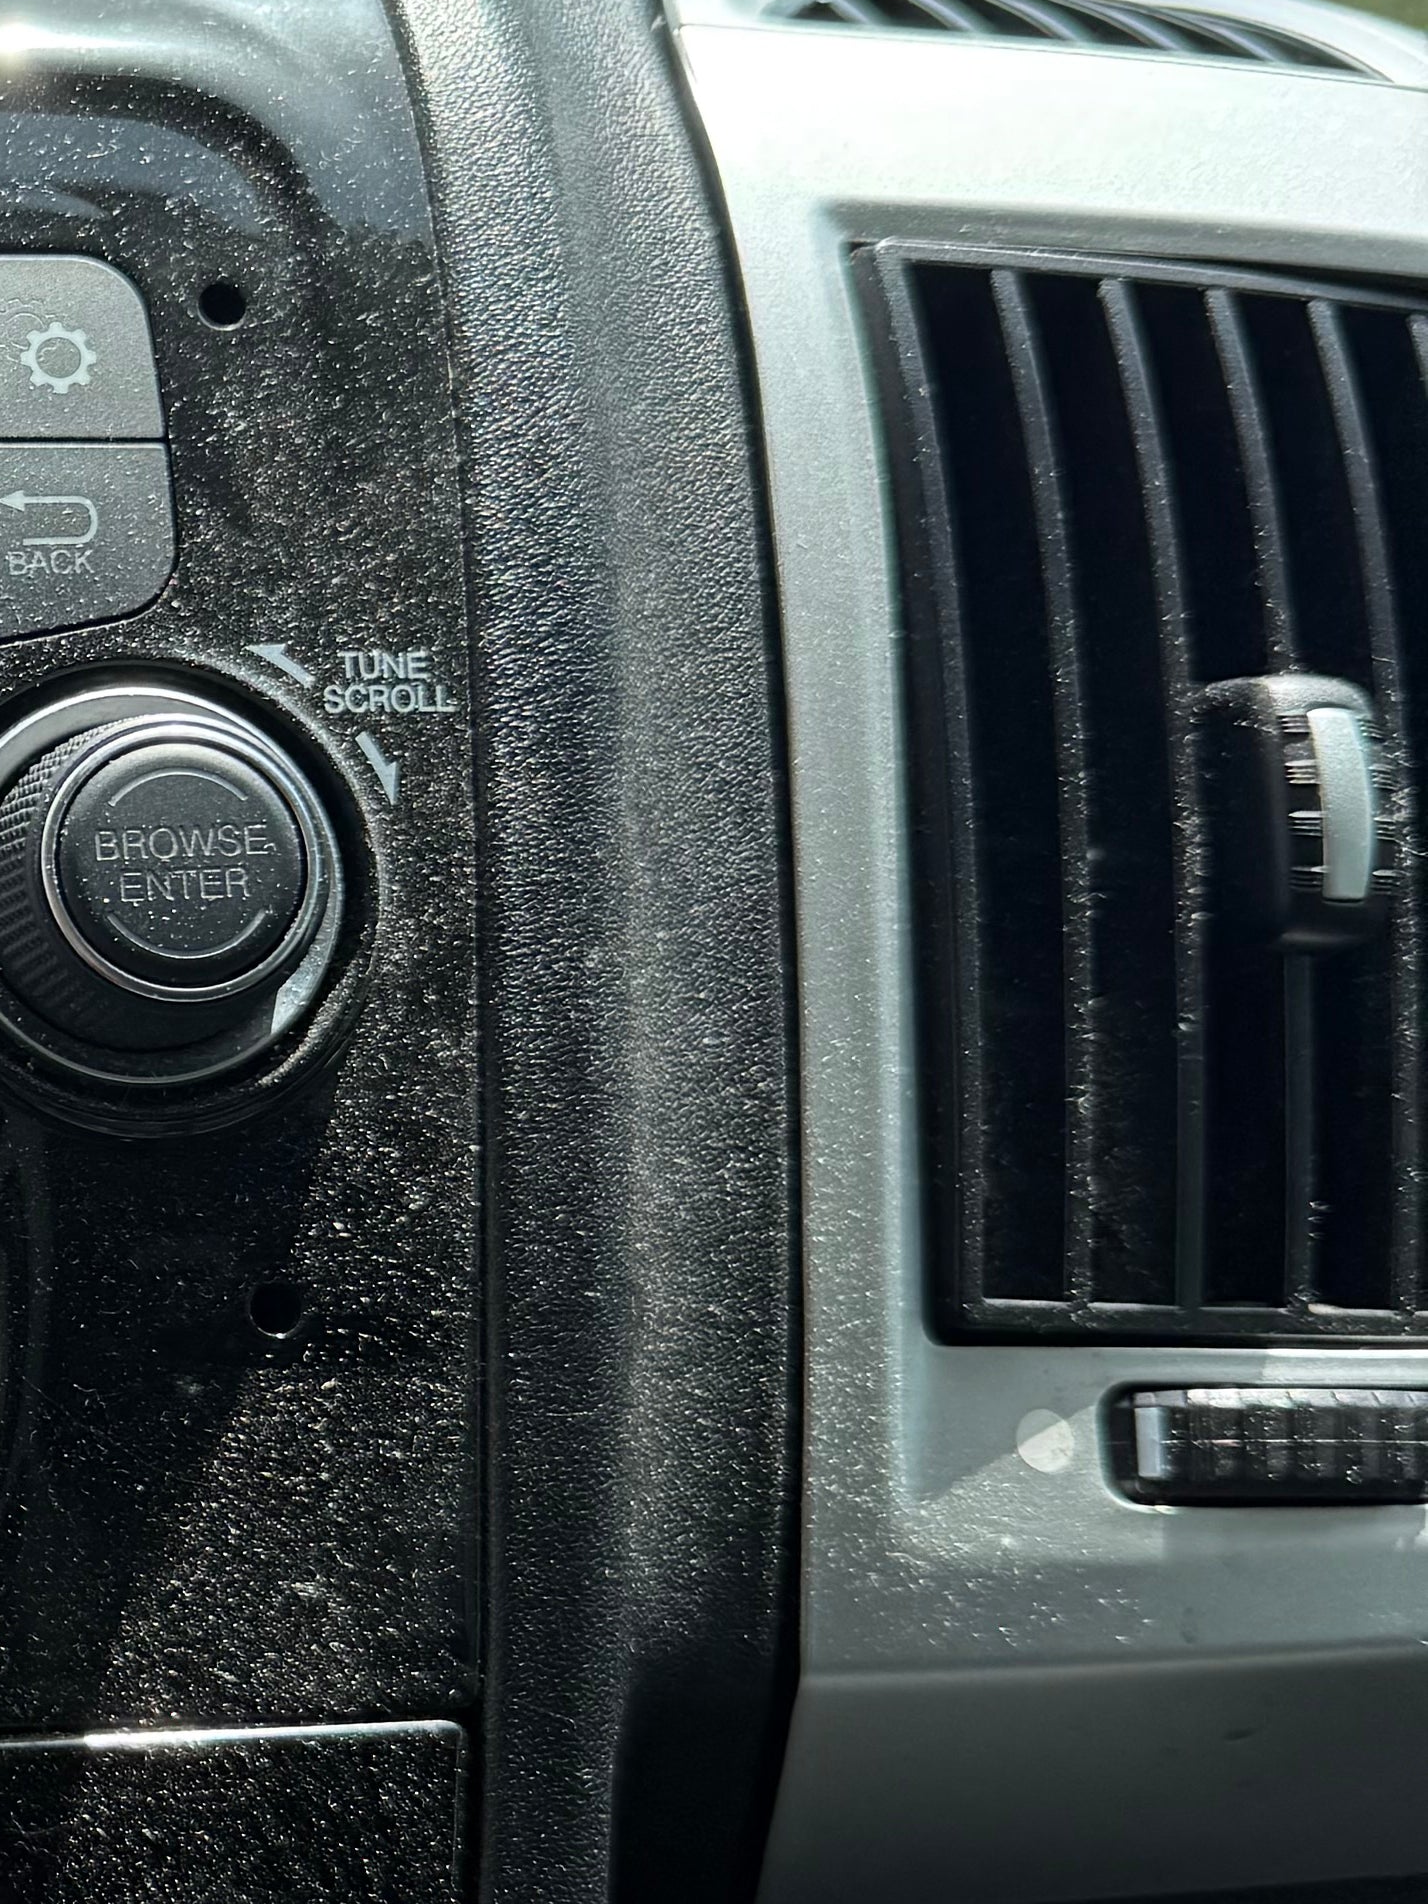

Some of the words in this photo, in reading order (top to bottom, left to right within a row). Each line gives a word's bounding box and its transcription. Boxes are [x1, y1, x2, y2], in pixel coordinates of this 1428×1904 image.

[8, 549, 94, 576] BACK
[343, 651, 429, 681] TUNE
[324, 682, 456, 714] SCROLL
[94, 824, 270, 861] BROWSE
[119, 867, 252, 903] ENTER
